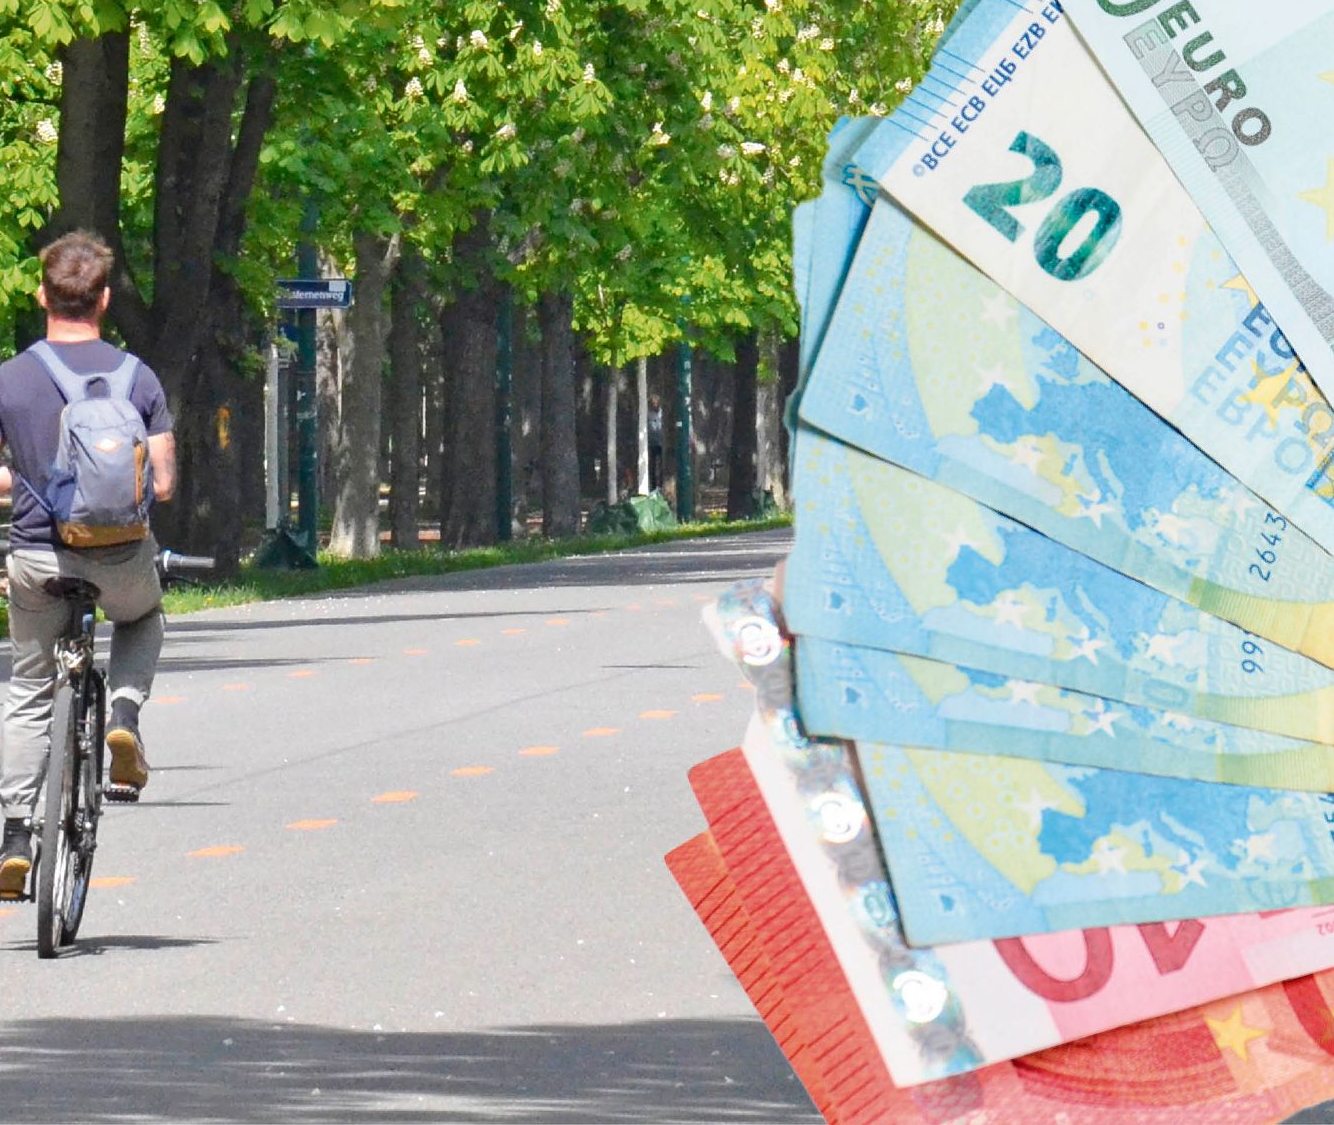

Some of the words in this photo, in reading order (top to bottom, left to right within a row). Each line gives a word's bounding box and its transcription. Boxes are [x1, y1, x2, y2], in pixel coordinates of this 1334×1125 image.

[951, 95, 986, 133] ECB
[982, 58, 1017, 97] ЕЦБ
[1012, 22, 1045, 60] EZB
[962, 130, 1123, 282] 20
[1249, 512, 1287, 582] 2643
